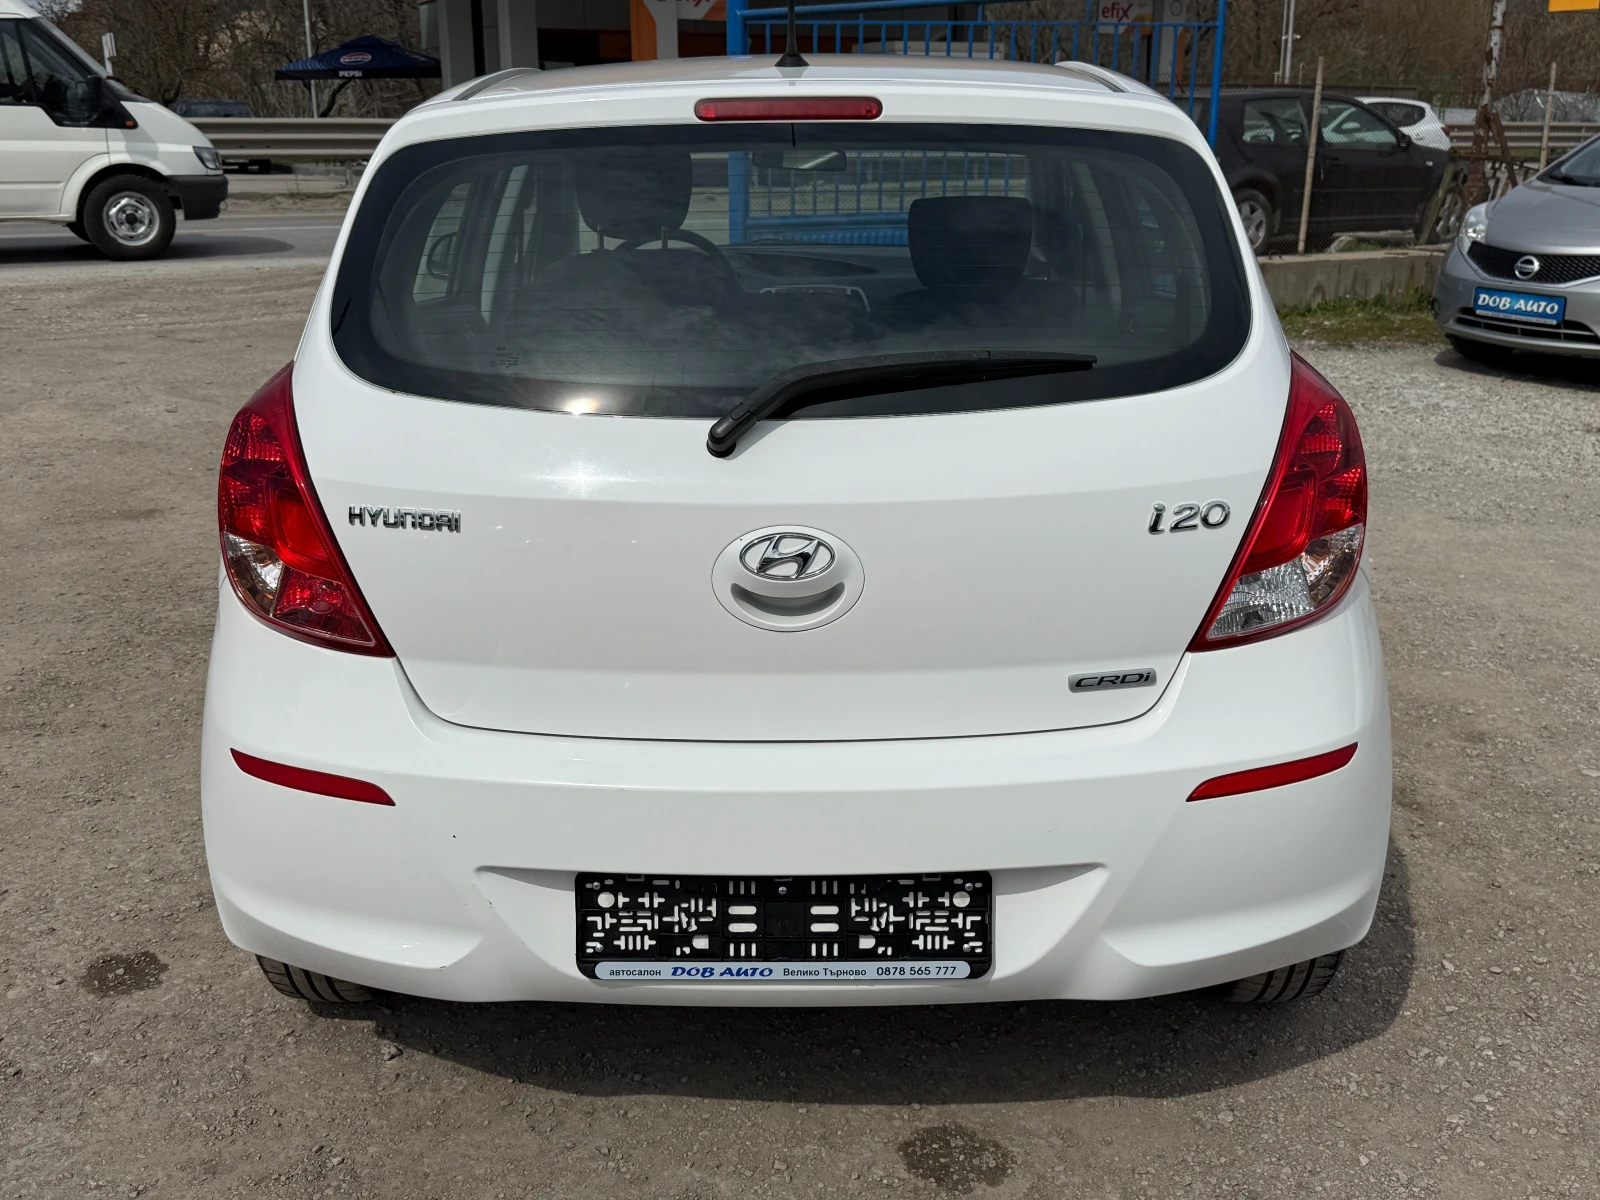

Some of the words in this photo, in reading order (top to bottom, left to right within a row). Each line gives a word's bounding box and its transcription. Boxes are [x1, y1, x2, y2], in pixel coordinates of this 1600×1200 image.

[1101, 2, 1133, 22] efix
[338, 70, 363, 78] PEPSI
[1477, 293, 1512, 311] DOB
[1513, 298, 1559, 315] AUTO
[348, 504, 461, 533] HYUNDAI
[1148, 499, 1231, 535] i20
[1075, 672, 1151, 688] CRDi
[609, 968, 661, 977] автосалон
[671, 966, 715, 978] DOB
[719, 967, 774, 978] AUTO
[783, 968, 820, 977] Велико
[823, 968, 867, 979] Търново
[876, 966, 906, 976] 0878
[909, 966, 931, 976] 565
[935, 966, 957, 975] 777
